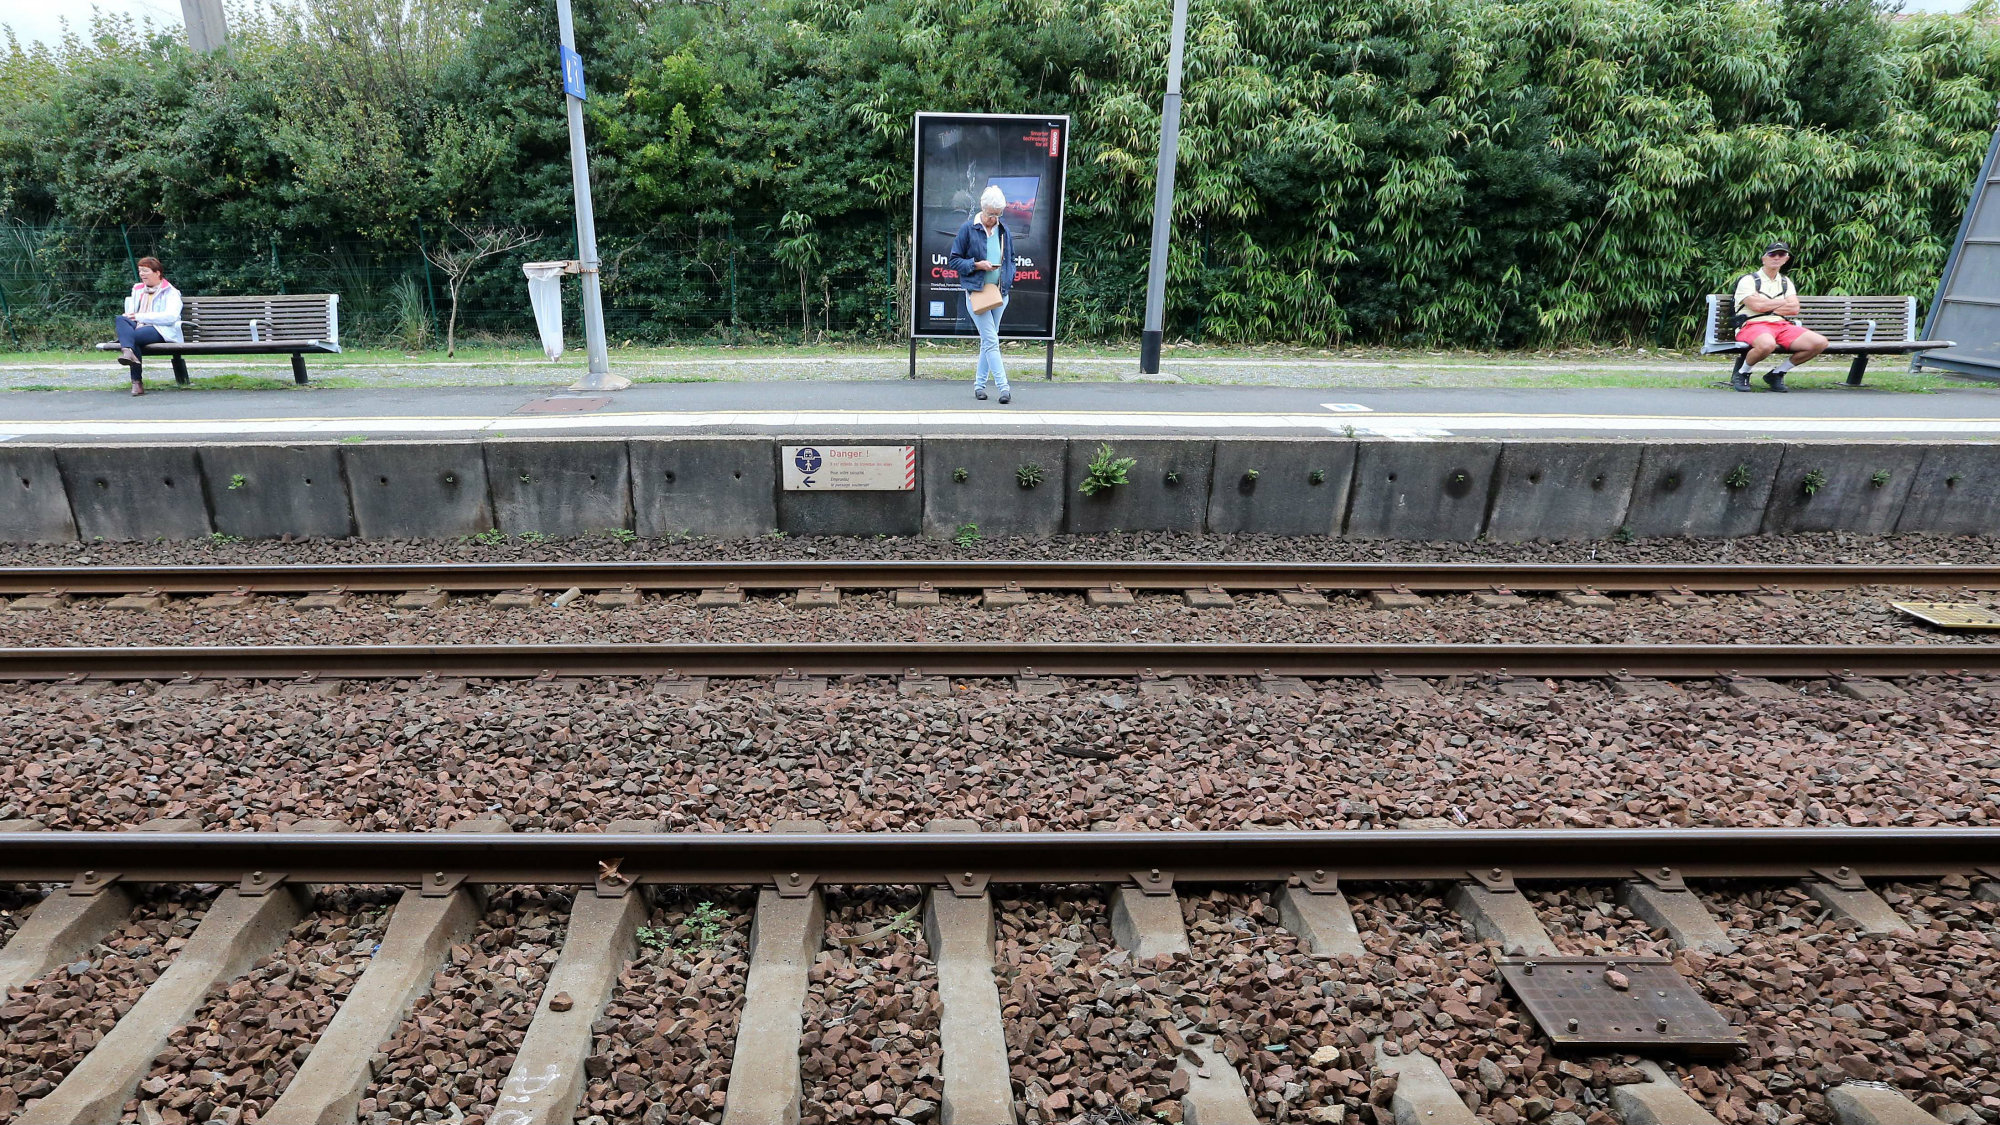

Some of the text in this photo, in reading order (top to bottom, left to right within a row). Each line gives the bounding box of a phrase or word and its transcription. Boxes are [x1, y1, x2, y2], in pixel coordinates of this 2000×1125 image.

[931, 253, 948, 265] Un
[931, 267, 959, 279] C'est
[829, 449, 862, 459] Danger
